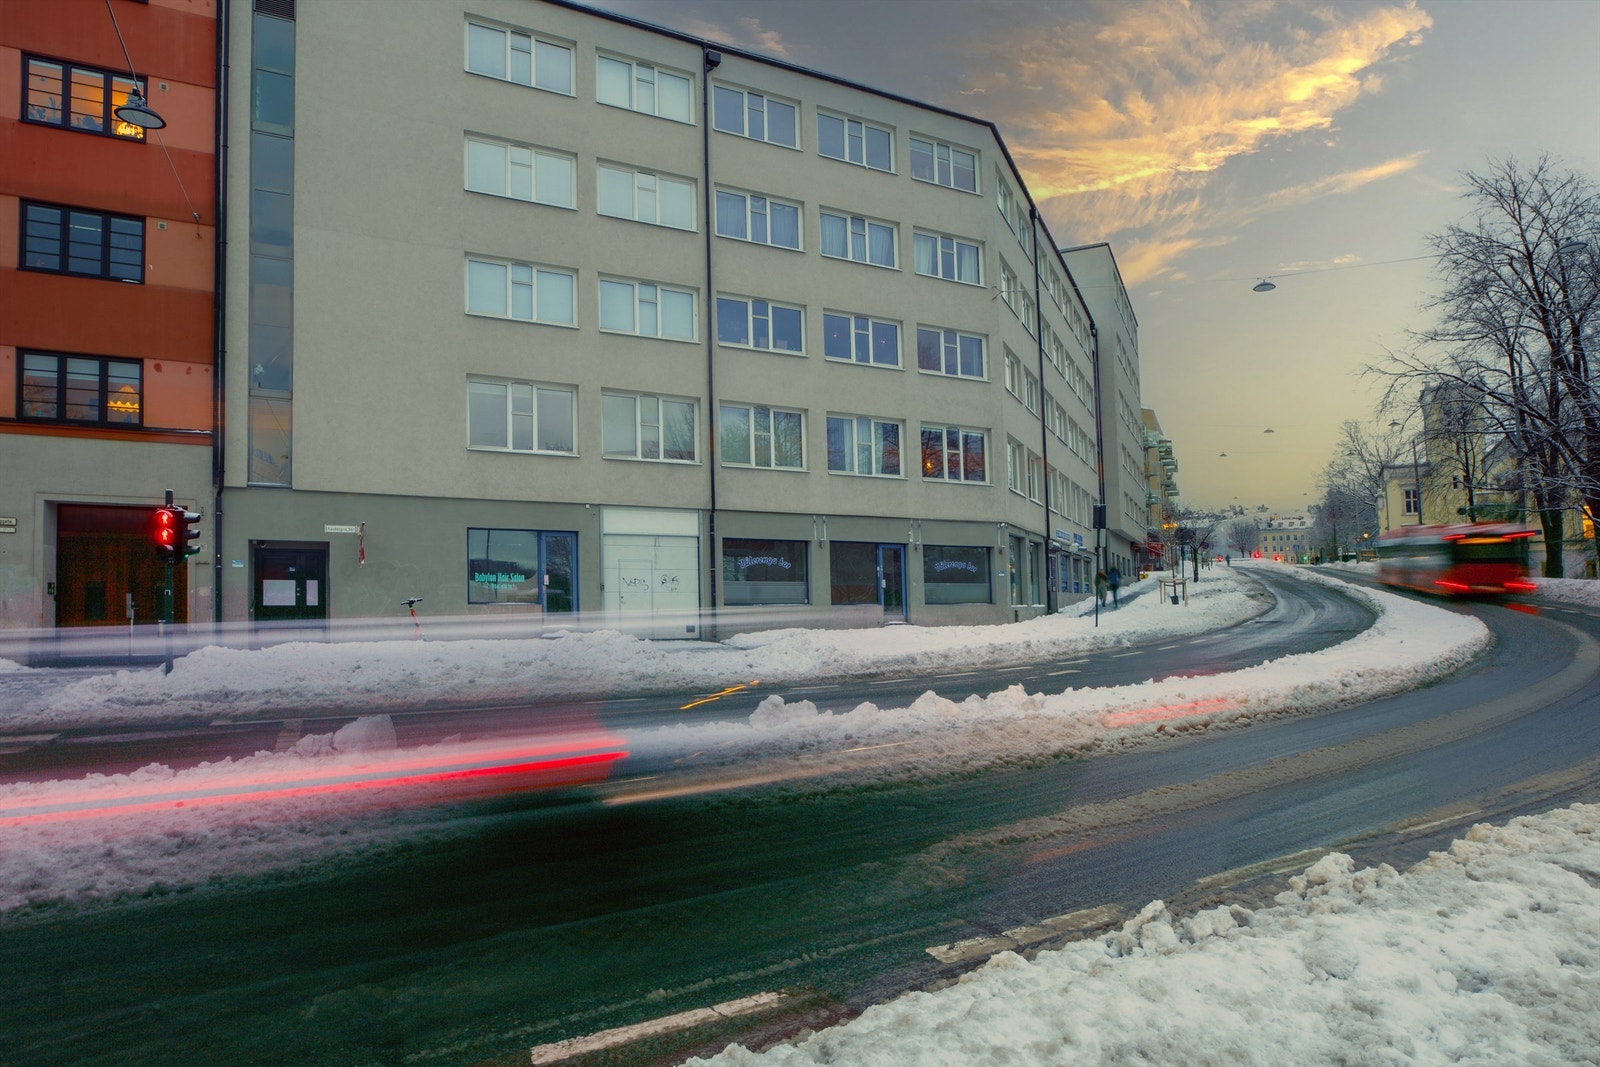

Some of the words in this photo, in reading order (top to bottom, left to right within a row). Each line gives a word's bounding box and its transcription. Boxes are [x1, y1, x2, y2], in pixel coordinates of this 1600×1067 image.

[474, 572, 497, 583] Babylon
[497, 572, 509, 582] Hair
[510, 572, 525, 582] Salon
